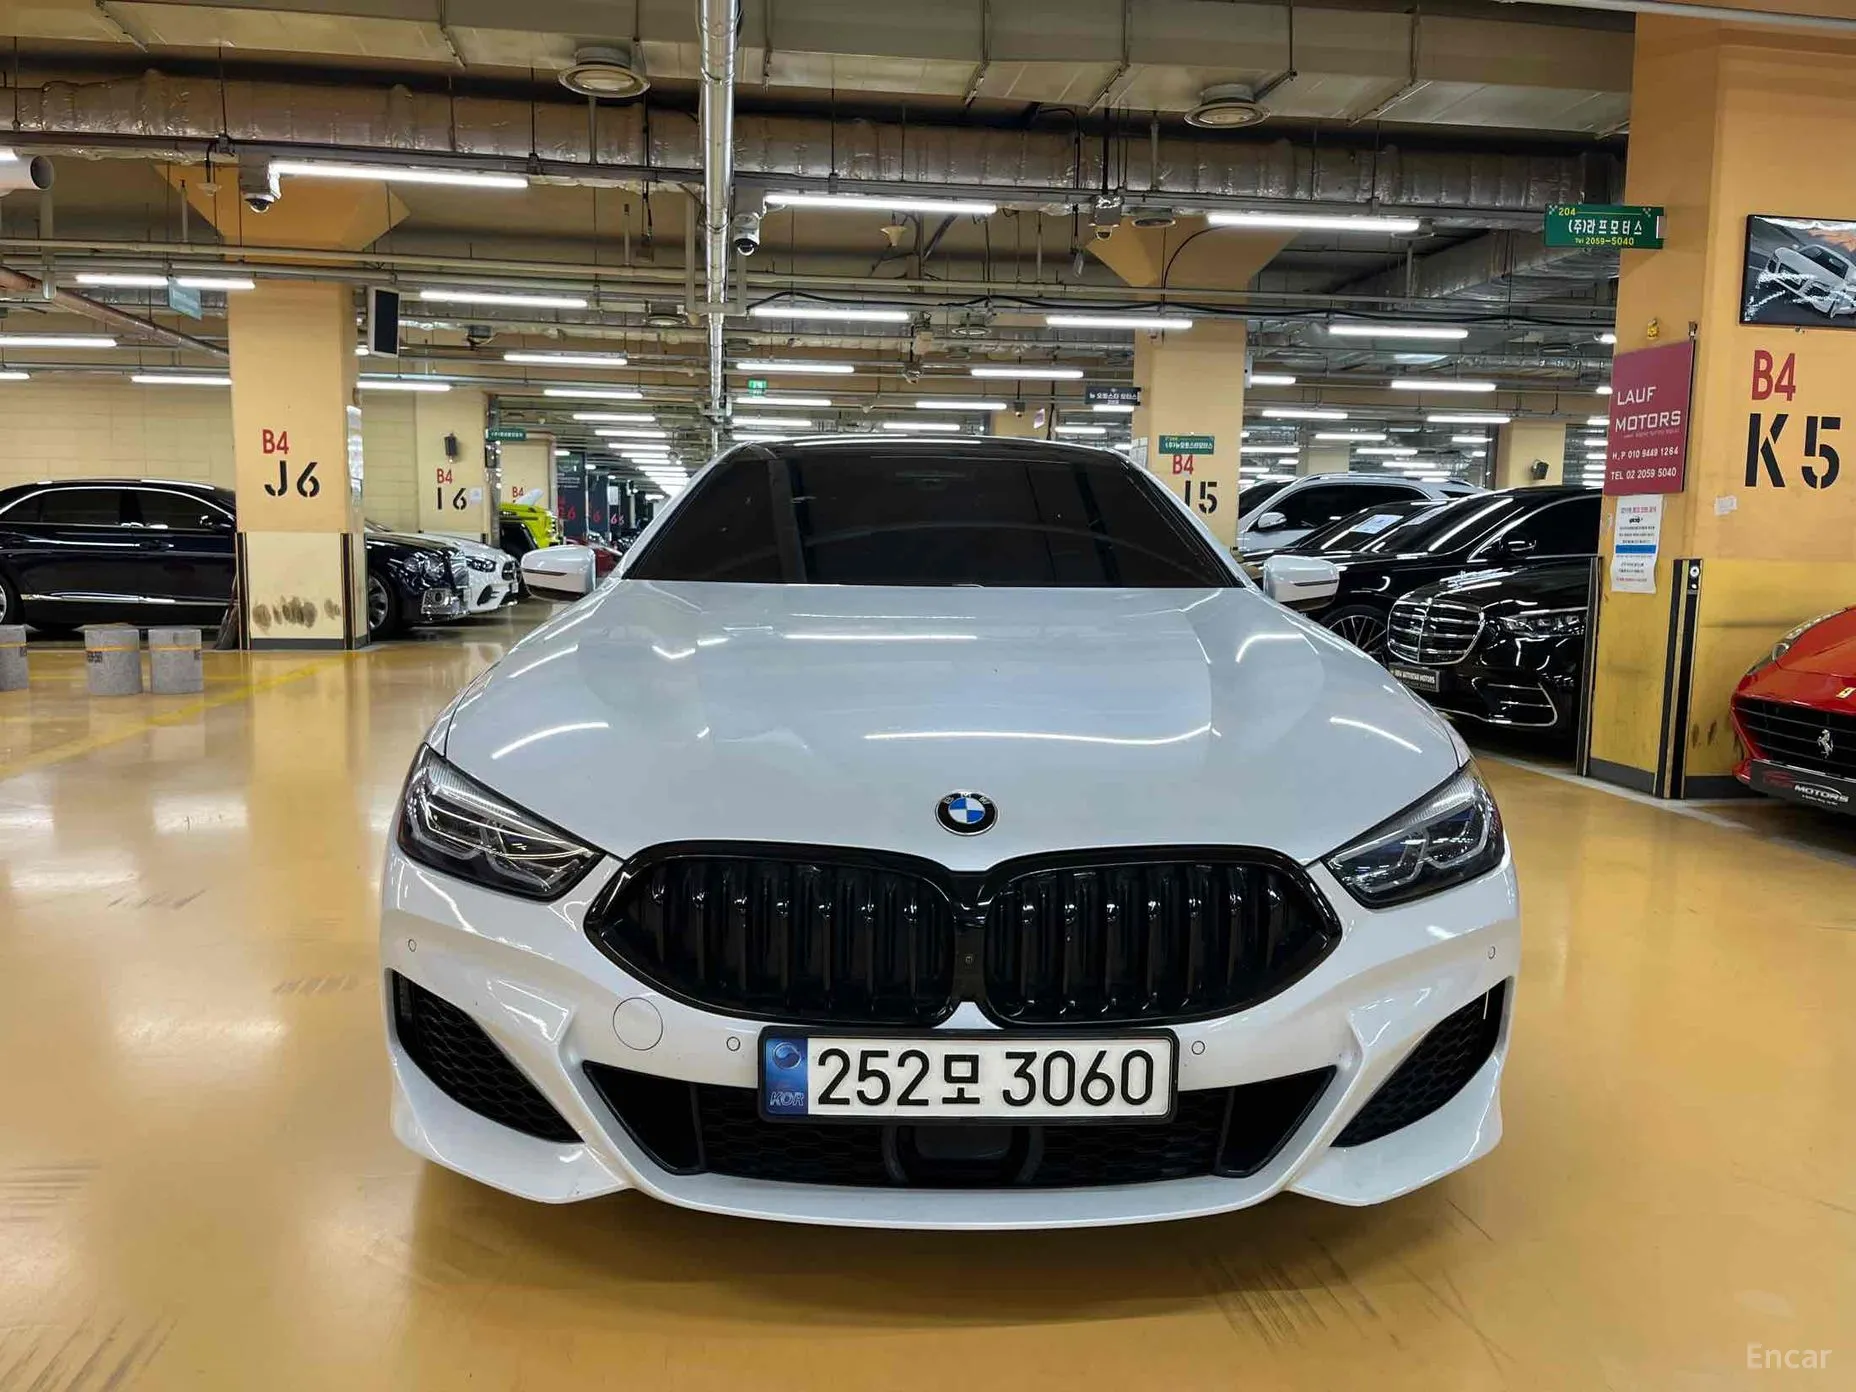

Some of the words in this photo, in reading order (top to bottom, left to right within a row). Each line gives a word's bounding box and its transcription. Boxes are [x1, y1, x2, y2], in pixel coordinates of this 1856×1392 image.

[1558, 207, 1576, 216] 204
[1568, 219, 1642, 235] (주)라프모터스
[1586, 237, 1634, 246] 2059-5040
[1751, 349, 1796, 402] B4
[1617, 386, 1657, 406] LAUF
[1615, 410, 1681, 432] MOTORS
[262, 428, 289, 455] B4
[1627, 449, 1640, 459] 010
[1660, 446, 1679, 456] 1264
[1173, 454, 1193, 475] B4
[1626, 469, 1636, 479] 02
[1637, 468, 1656, 478] 2059
[1657, 466, 1677, 477] 5040
[437, 468, 453, 484] B4
[512, 487, 524, 498] B4
[1795, 784, 1849, 803] MOTORS
[1002, 1050, 1154, 1107] 3060
[769, 1091, 804, 1107] KOR
